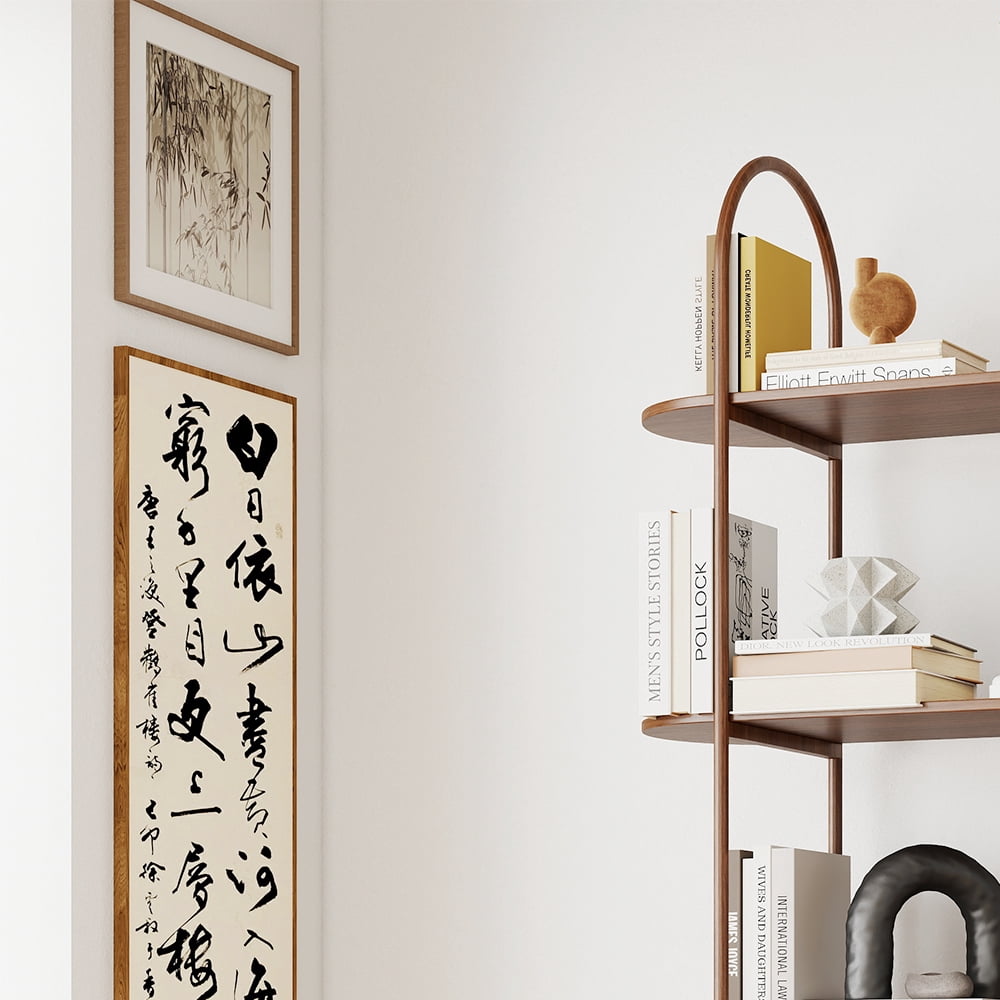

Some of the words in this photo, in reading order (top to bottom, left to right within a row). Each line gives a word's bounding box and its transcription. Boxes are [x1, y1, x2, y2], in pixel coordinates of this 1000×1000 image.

[766, 374, 811, 391] Elliott
[647, 520, 661, 591] STORIES
[648, 595, 661, 646] STYLE
[694, 562, 708, 661] POLLOCK
[769, 610, 778, 640] CK
[774, 640, 804, 649] NEW
[808, 639, 842, 648] LOOK
[845, 635, 926, 647] REVOLUTION
[648, 652, 661, 702] MEN'S
[757, 865, 766, 903] WIVES
[757, 906, 766, 931] AND
[777, 895, 788, 976] INTERNATIONAL
[777, 979, 788, 1000] LAW
